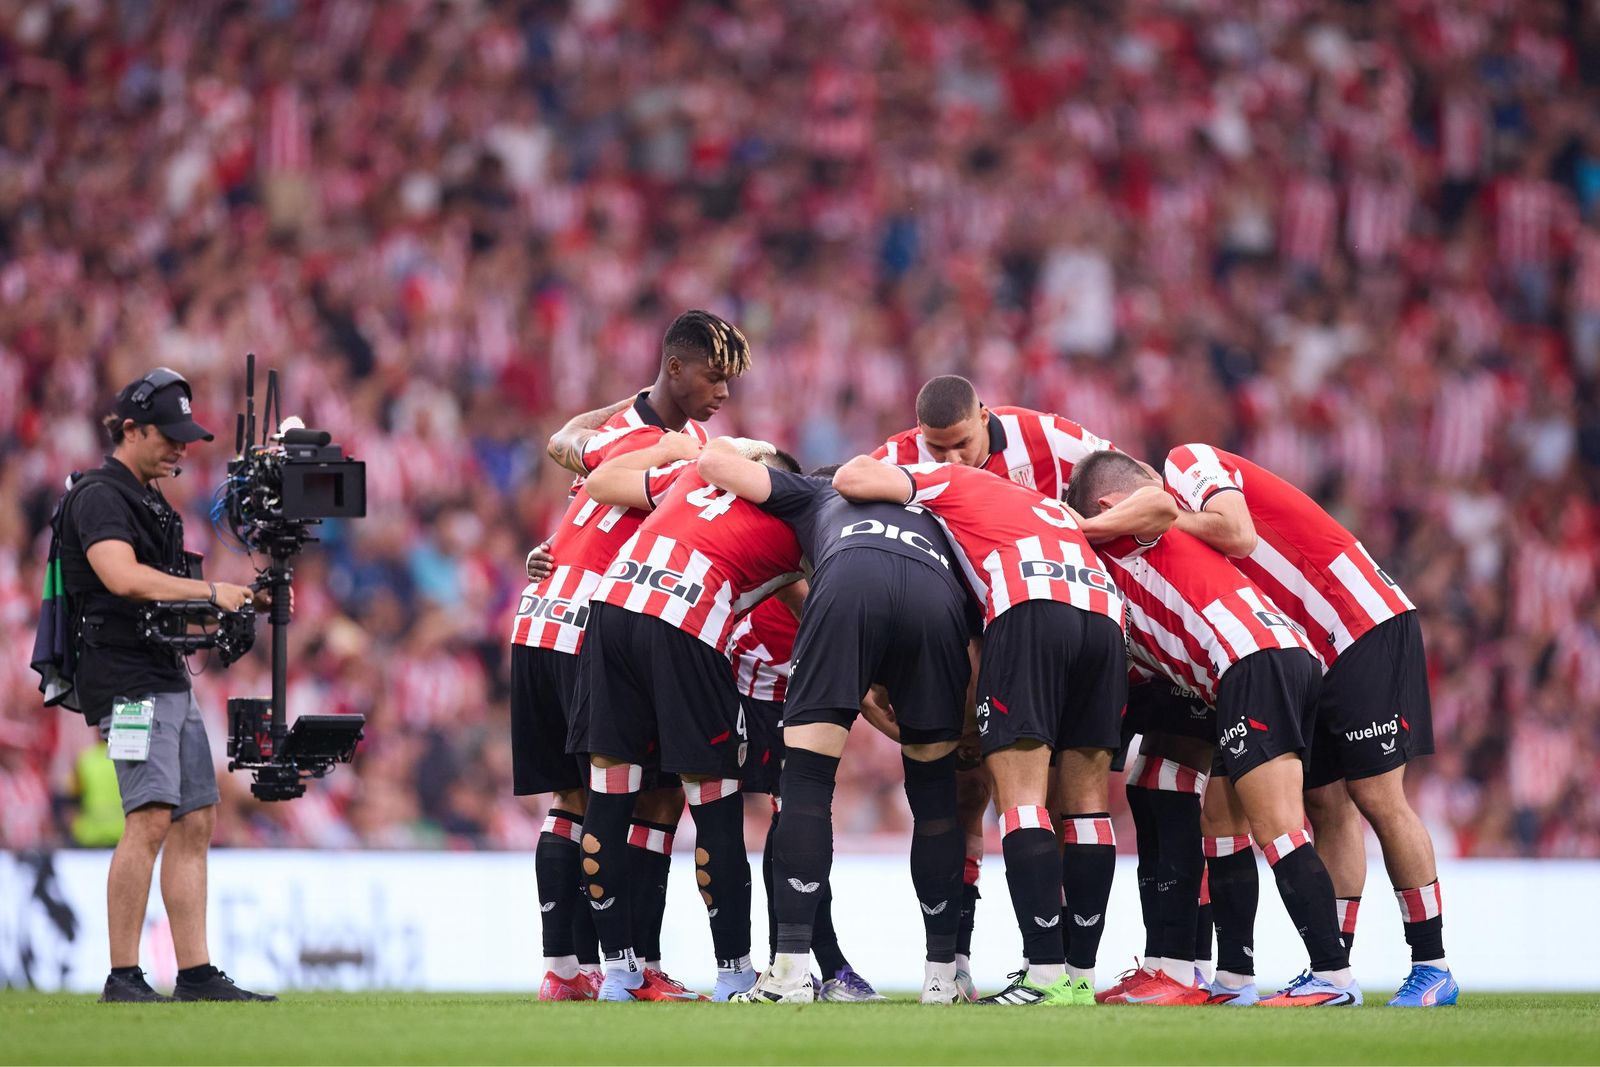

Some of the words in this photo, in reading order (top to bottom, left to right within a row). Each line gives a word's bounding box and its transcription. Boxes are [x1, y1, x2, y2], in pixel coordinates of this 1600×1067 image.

[686, 483, 737, 522] 4
[606, 561, 703, 605] DIGI
[517, 595, 590, 628] DIGI
[1345, 713, 1398, 742] vueling
